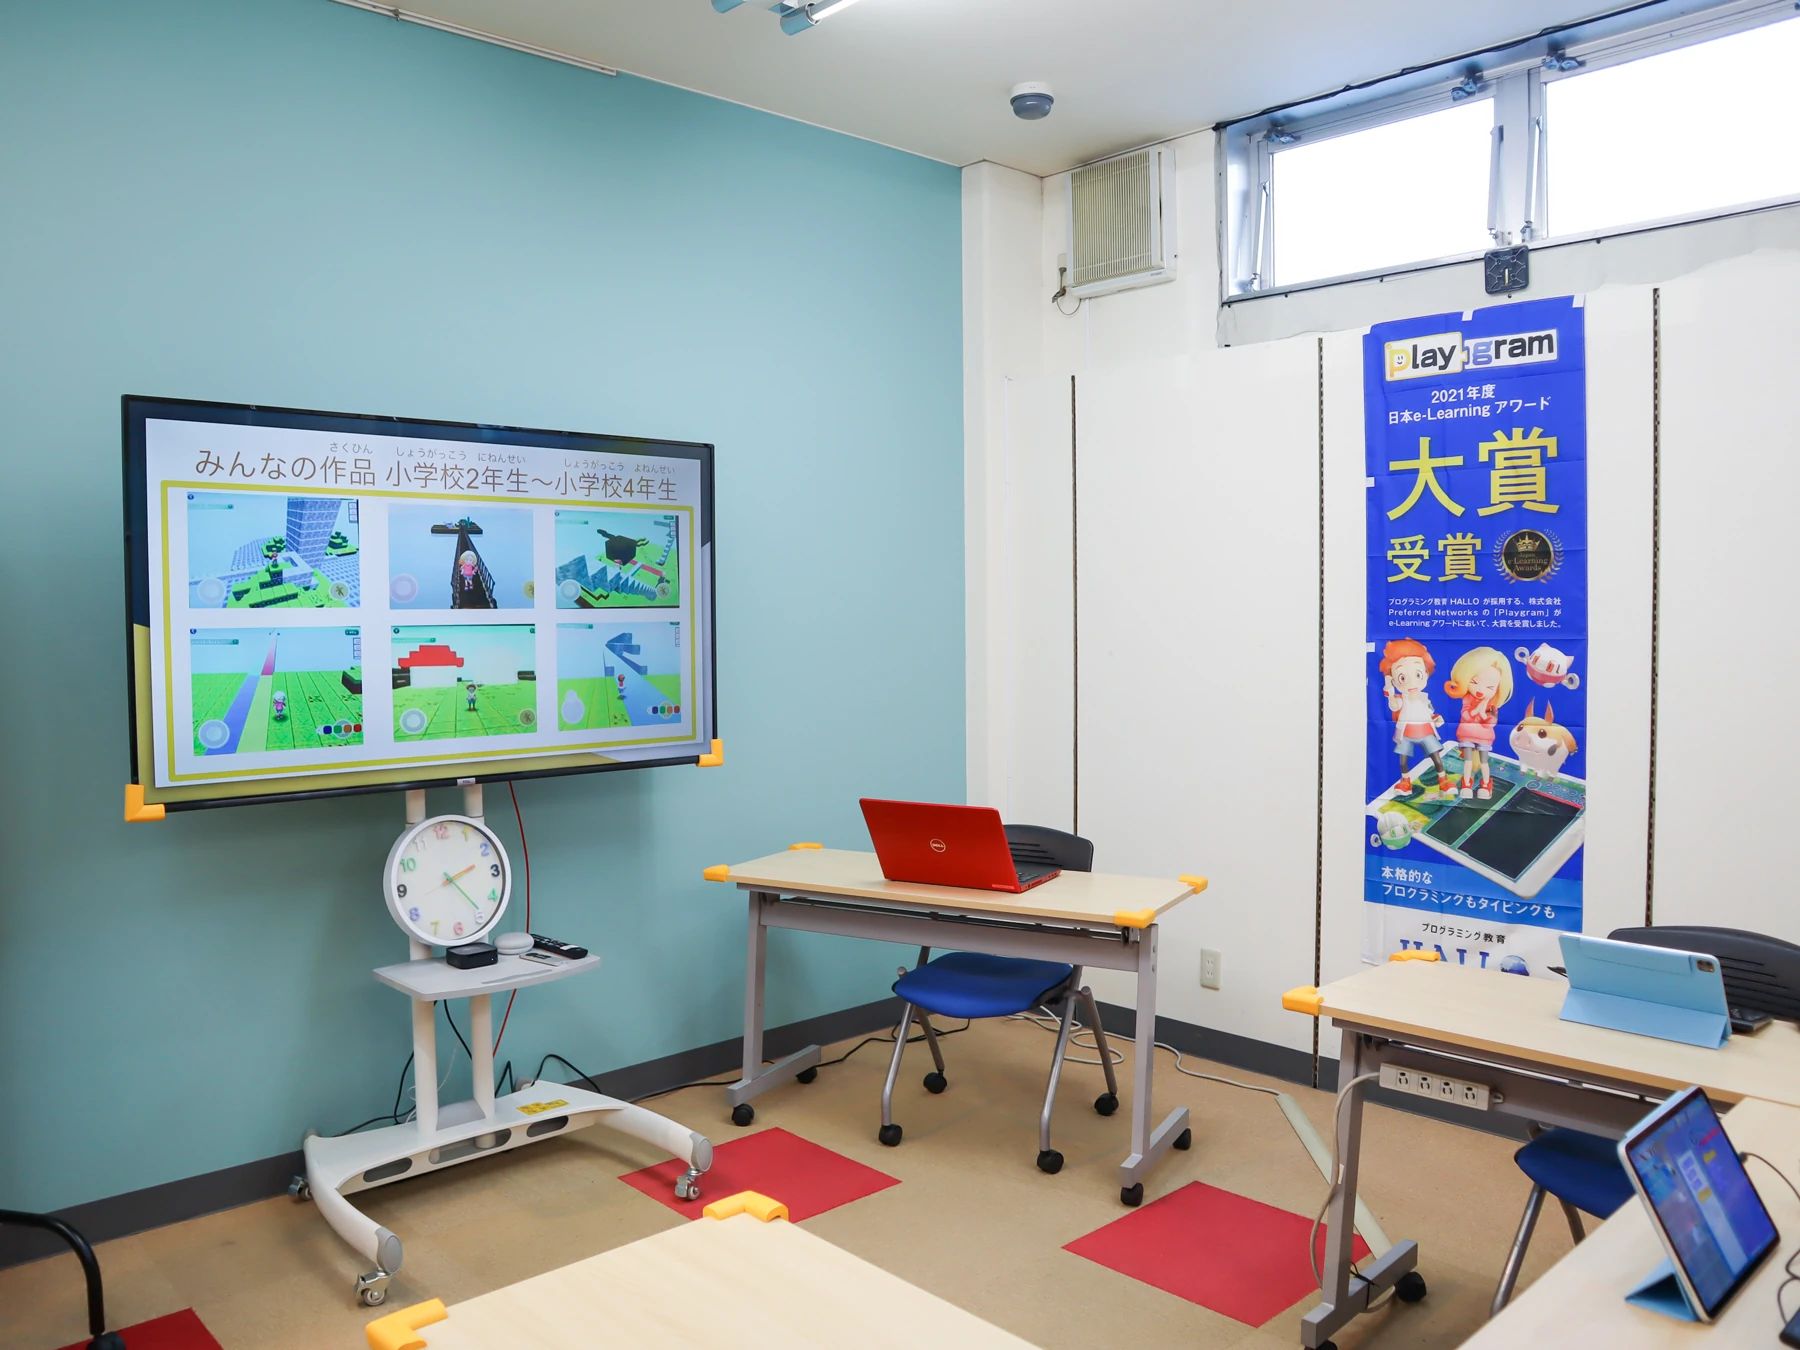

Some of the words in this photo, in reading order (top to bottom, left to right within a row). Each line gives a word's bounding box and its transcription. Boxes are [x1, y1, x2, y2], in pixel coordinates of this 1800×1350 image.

[1431, 384, 1496, 403] 2021年度
[1495, 396, 1552, 414] アワード
[329, 442, 373, 454] さくひん
[396, 446, 467, 461] しょうがっこう
[478, 452, 526, 464] にねんせい
[564, 458, 625, 472] しょうがっこう
[195, 450, 376, 486] みんなの作品
[1386, 426, 1560, 521] 大賞
[1386, 532, 1483, 583] 受賞
[480, 842, 490, 856] 2
[400, 858, 416, 872] 10
[490, 864, 500, 877] 3
[1381, 866, 1433, 885] 本格的な
[397, 884, 407, 898] 9
[487, 888, 499, 902] 4
[1382, 884, 1556, 919] プログラミングもタイピングも
[409, 907, 420, 921] 8
[430, 921, 439, 936] 7
[453, 922, 464, 936] 6
[1421, 923, 1507, 944] プログラミング教育
